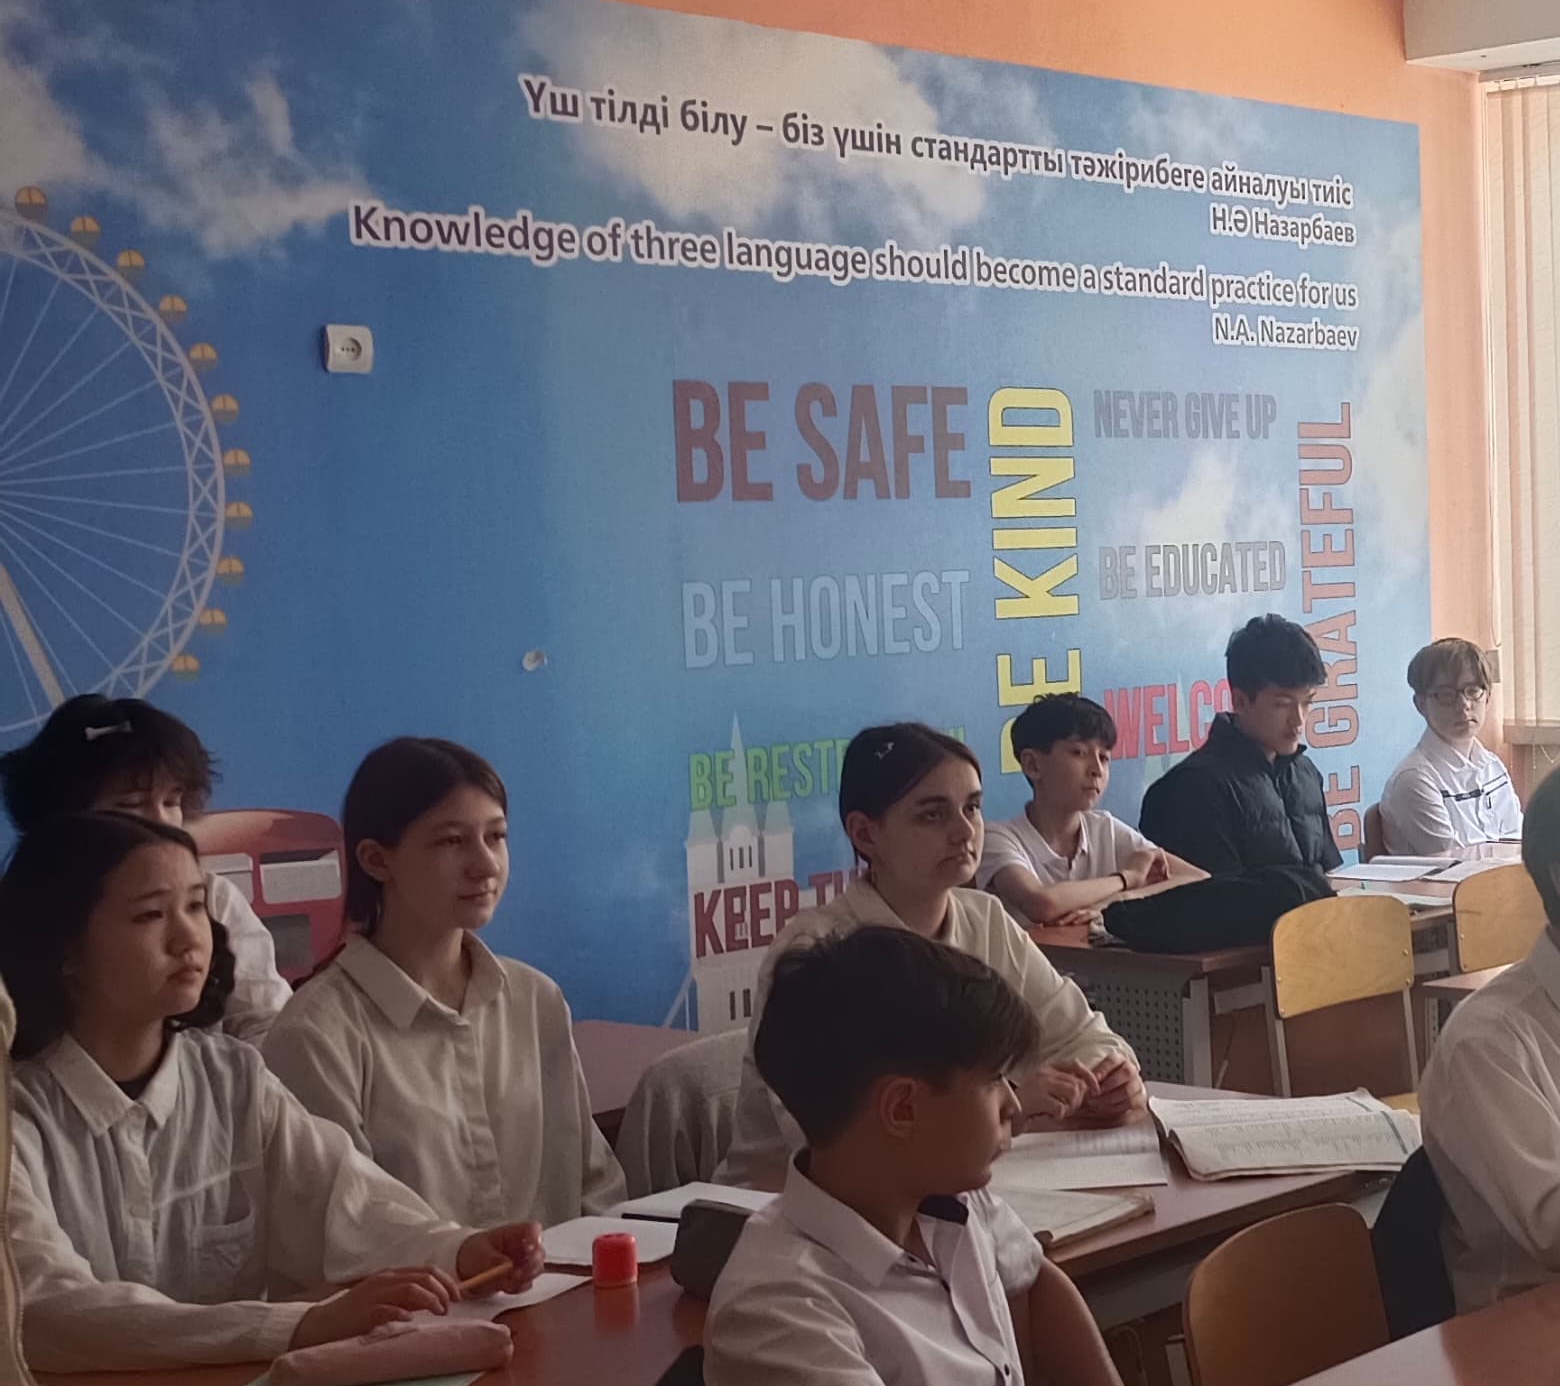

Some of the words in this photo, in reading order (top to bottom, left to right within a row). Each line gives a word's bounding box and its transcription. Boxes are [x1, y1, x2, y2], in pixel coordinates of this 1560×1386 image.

[523, 79, 579, 119] Үш
[590, 88, 669, 136] тілді
[680, 99, 748, 147] білу
[782, 112, 825, 147] біз
[832, 122, 902, 159] үшін
[910, 135, 1064, 176] стандартты
[1070, 150, 1205, 192] тәжірибеге
[1210, 162, 1307, 205] айналуы
[1312, 180, 1352, 206] тиіс
[353, 204, 577, 261] Knowledge
[586, 222, 622, 257] of
[630, 226, 718, 264] three
[727, 231, 867, 282] language
[875, 244, 968, 282] should
[975, 251, 1076, 290] become
[1082, 267, 1097, 290] a
[1102, 265, 1204, 297] standard
[1210, 272, 1295, 305] practice
[1300, 276, 1332, 305] for
[1335, 284, 1358, 308] us
[1255, 211, 1355, 245] Назарбаев
[1213, 316, 1255, 343] N.A.
[1261, 319, 1358, 349] Nazarbaev
[672, 379, 774, 503] BE
[793, 382, 972, 501] SAFE
[1092, 389, 1181, 440] NEVER
[1184, 391, 1241, 440] GIVE
[1246, 394, 1277, 440] UP
[987, 386, 1080, 620] KIND
[681, 579, 755, 671] BE
[768, 569, 971, 663] HONEST
[1100, 544, 1138, 601] BE
[1144, 540, 1287, 599] EDUCATED
[1297, 401, 1360, 749] GRATEFUL
[996, 648, 1082, 775] E
[688, 748, 737, 812] BE
[693, 878, 800, 959] KEEP
